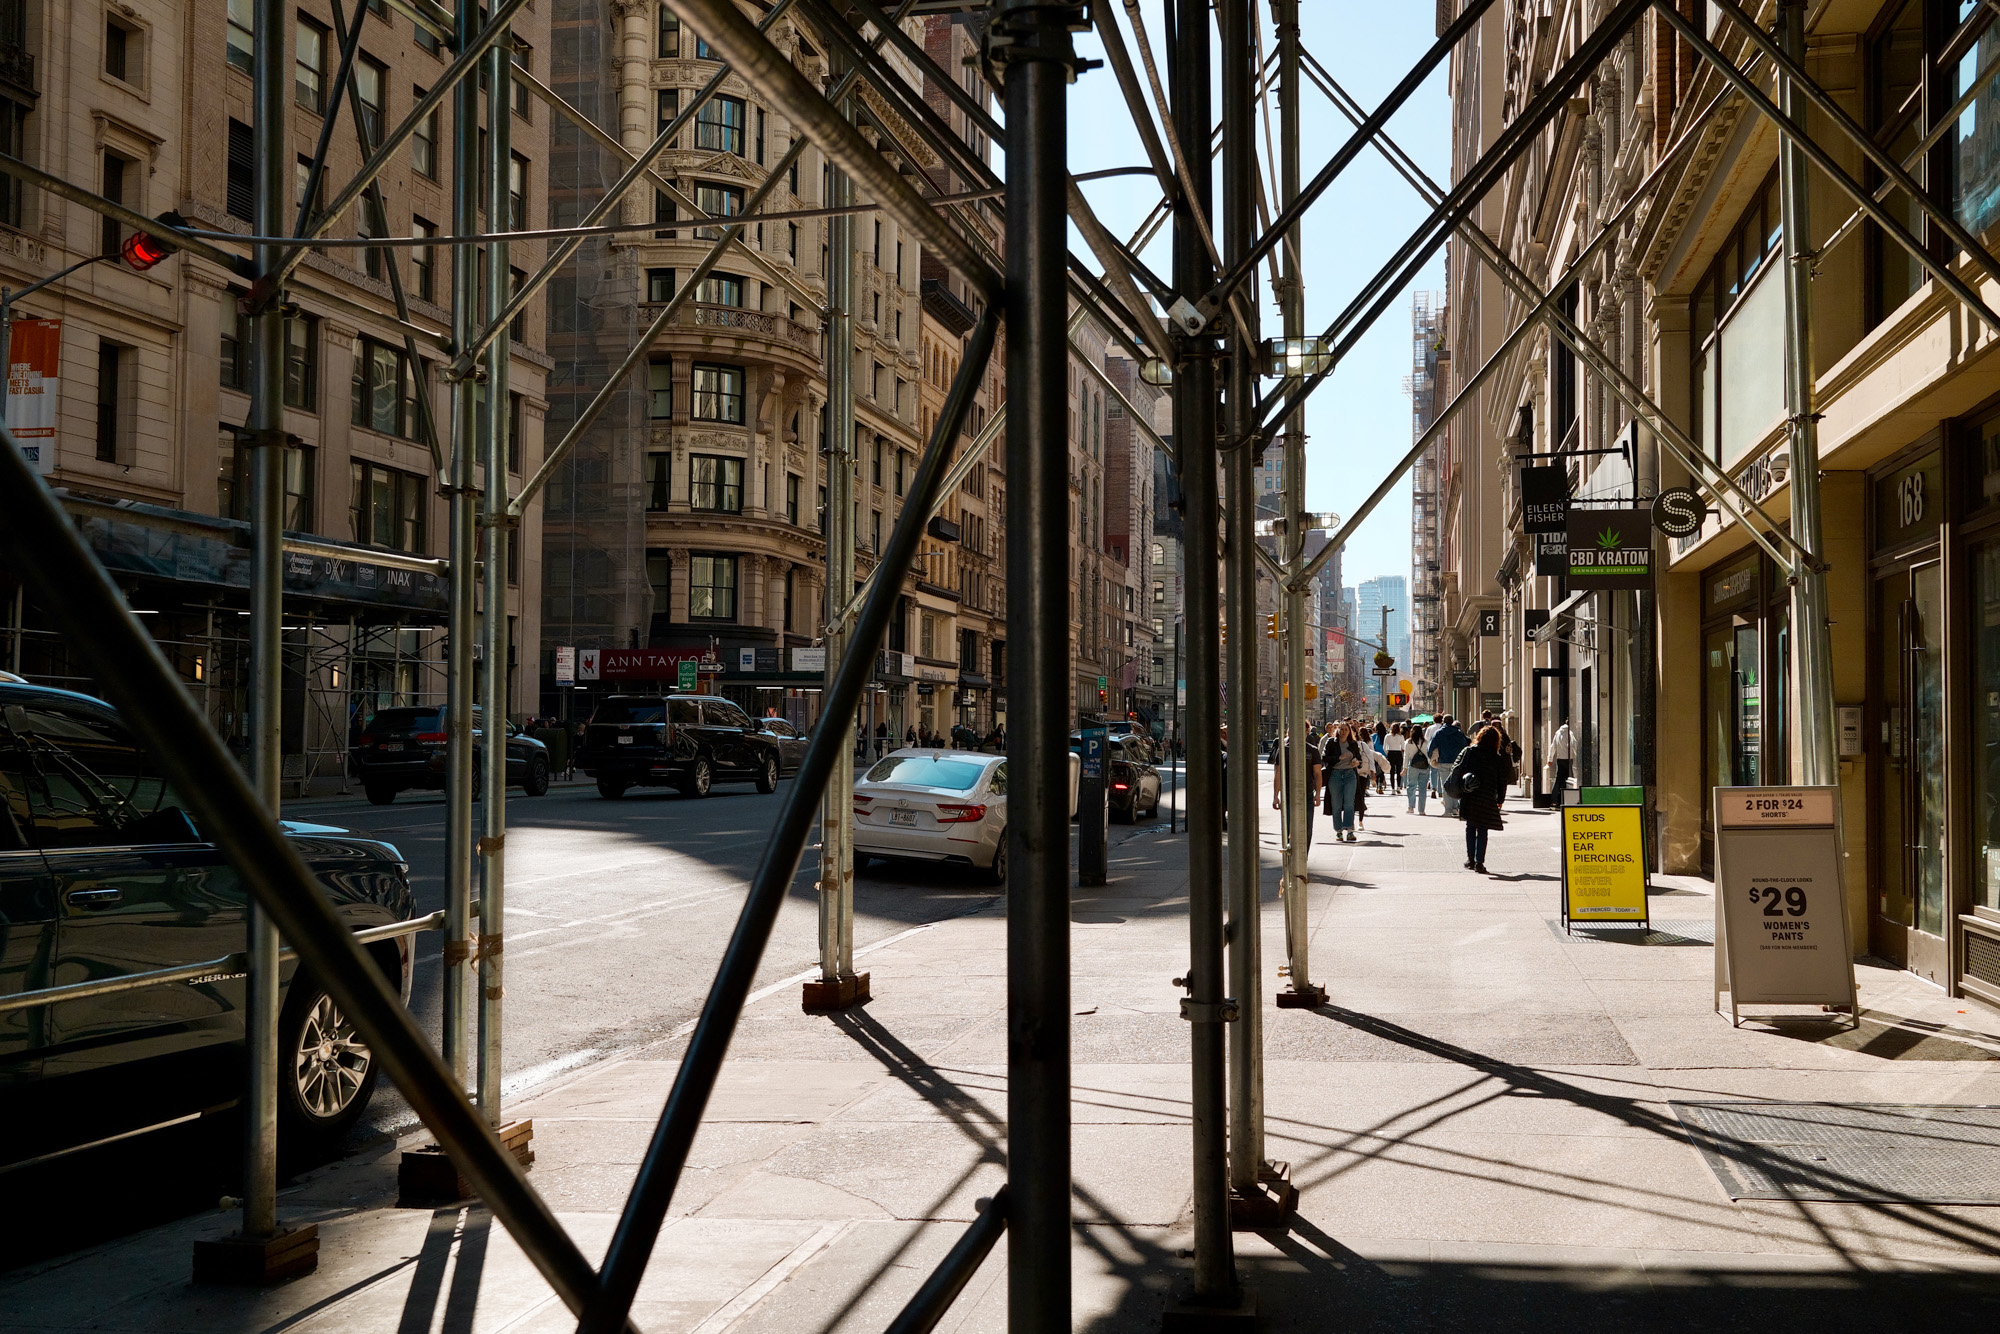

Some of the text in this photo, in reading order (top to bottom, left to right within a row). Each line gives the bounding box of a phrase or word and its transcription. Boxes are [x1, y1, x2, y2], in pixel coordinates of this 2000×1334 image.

[11, 363, 32, 371] WHERE
[9, 379, 29, 387] MEETS
[8, 386, 45, 395] FAST CASUAL
[1897, 472, 1924, 529] 168
[1527, 503, 1564, 513] EILEEN
[1662, 492, 1697, 532] S
[1527, 512, 1565, 523] FISHER
[1569, 550, 1648, 566] CBD KRATOM
[387, 570, 411, 586] INAX
[607, 655, 643, 667] ANN
[1088, 740, 1099, 755] P
[1746, 799, 1804, 810] 2 FOR $24
[1572, 814, 1605, 822] STUDS
[1572, 831, 1613, 840] EXPERT
[1573, 843, 1594, 851] EAR
[1573, 854, 1635, 864] PIERCINGS,
[1574, 865, 1626, 874] NEEDLES
[1574, 876, 1613, 886] NEVER
[1575, 888, 1611, 897] GUNS!
[1749, 886, 1807, 917] $29
[1763, 921, 1810, 930] WOMEN'S
[1772, 932, 1804, 941] PANTS
